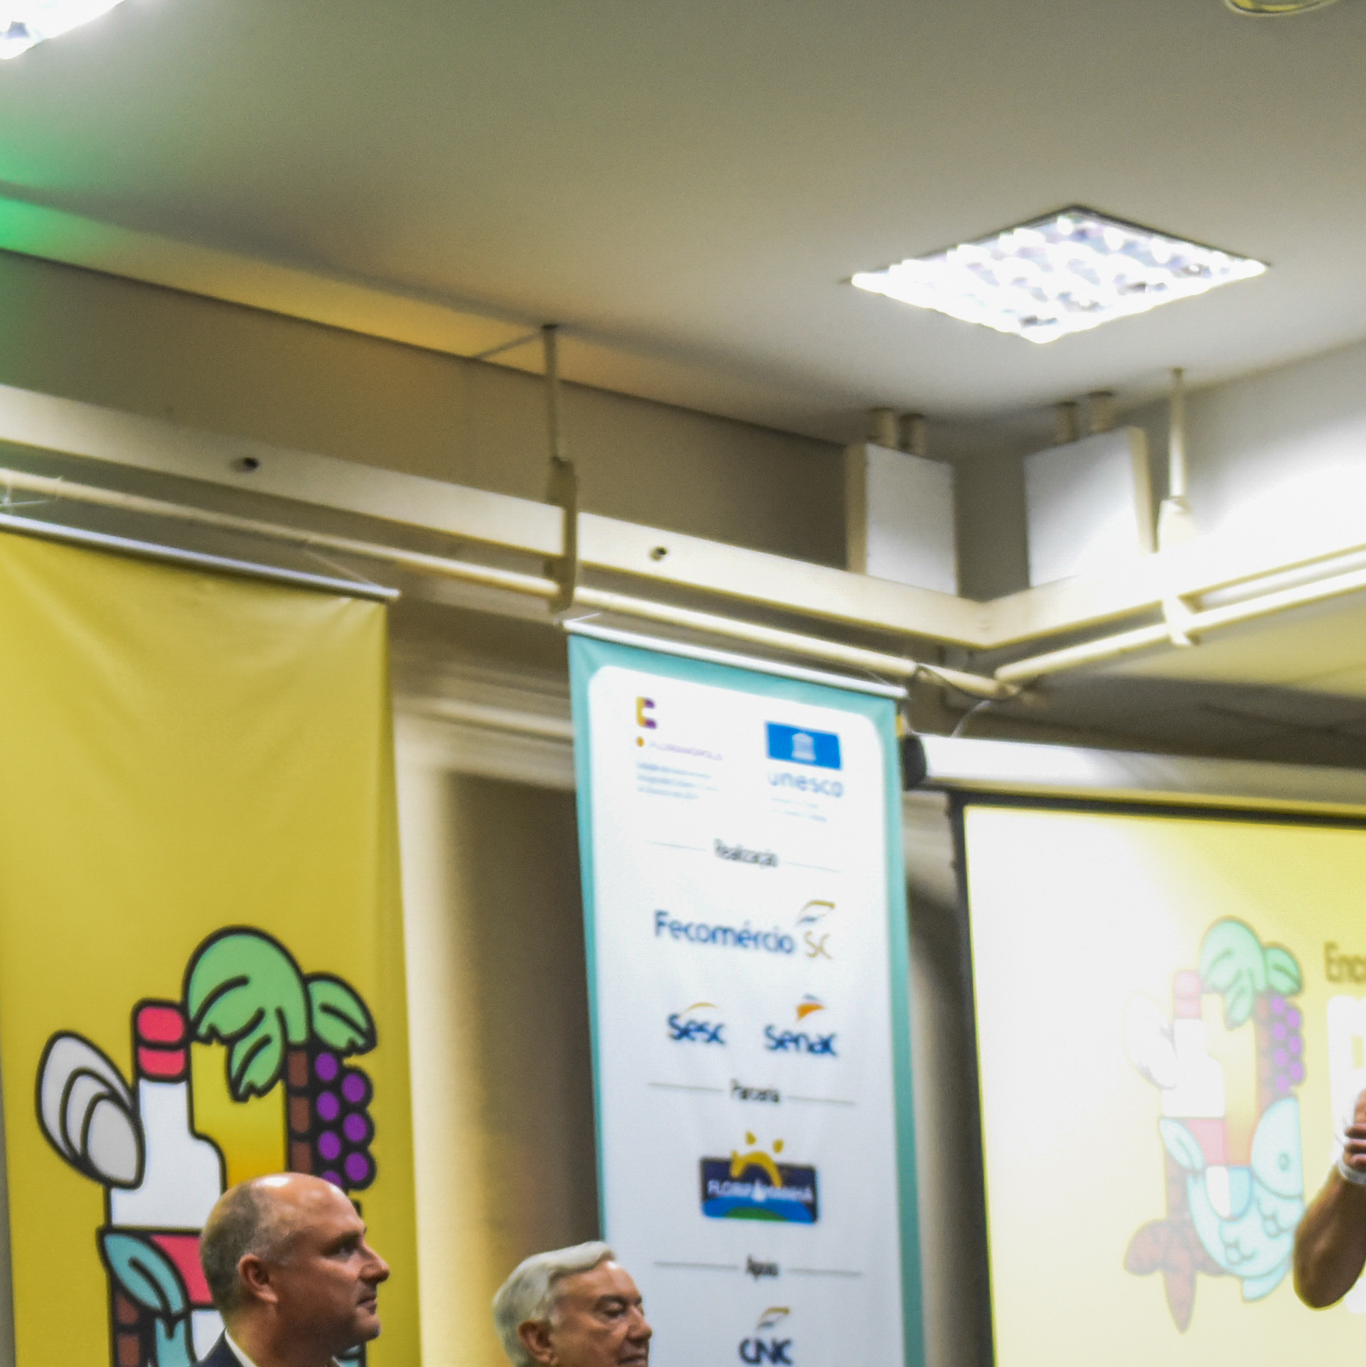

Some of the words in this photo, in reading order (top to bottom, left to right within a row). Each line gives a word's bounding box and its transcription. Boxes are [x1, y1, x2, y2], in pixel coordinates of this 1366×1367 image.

[767, 768, 843, 799] unesco
[653, 909, 796, 955] Fecomércio
[667, 1013, 727, 1047] Sesc
[764, 1025, 838, 1058] Senac
[739, 1338, 794, 1366] CNC
